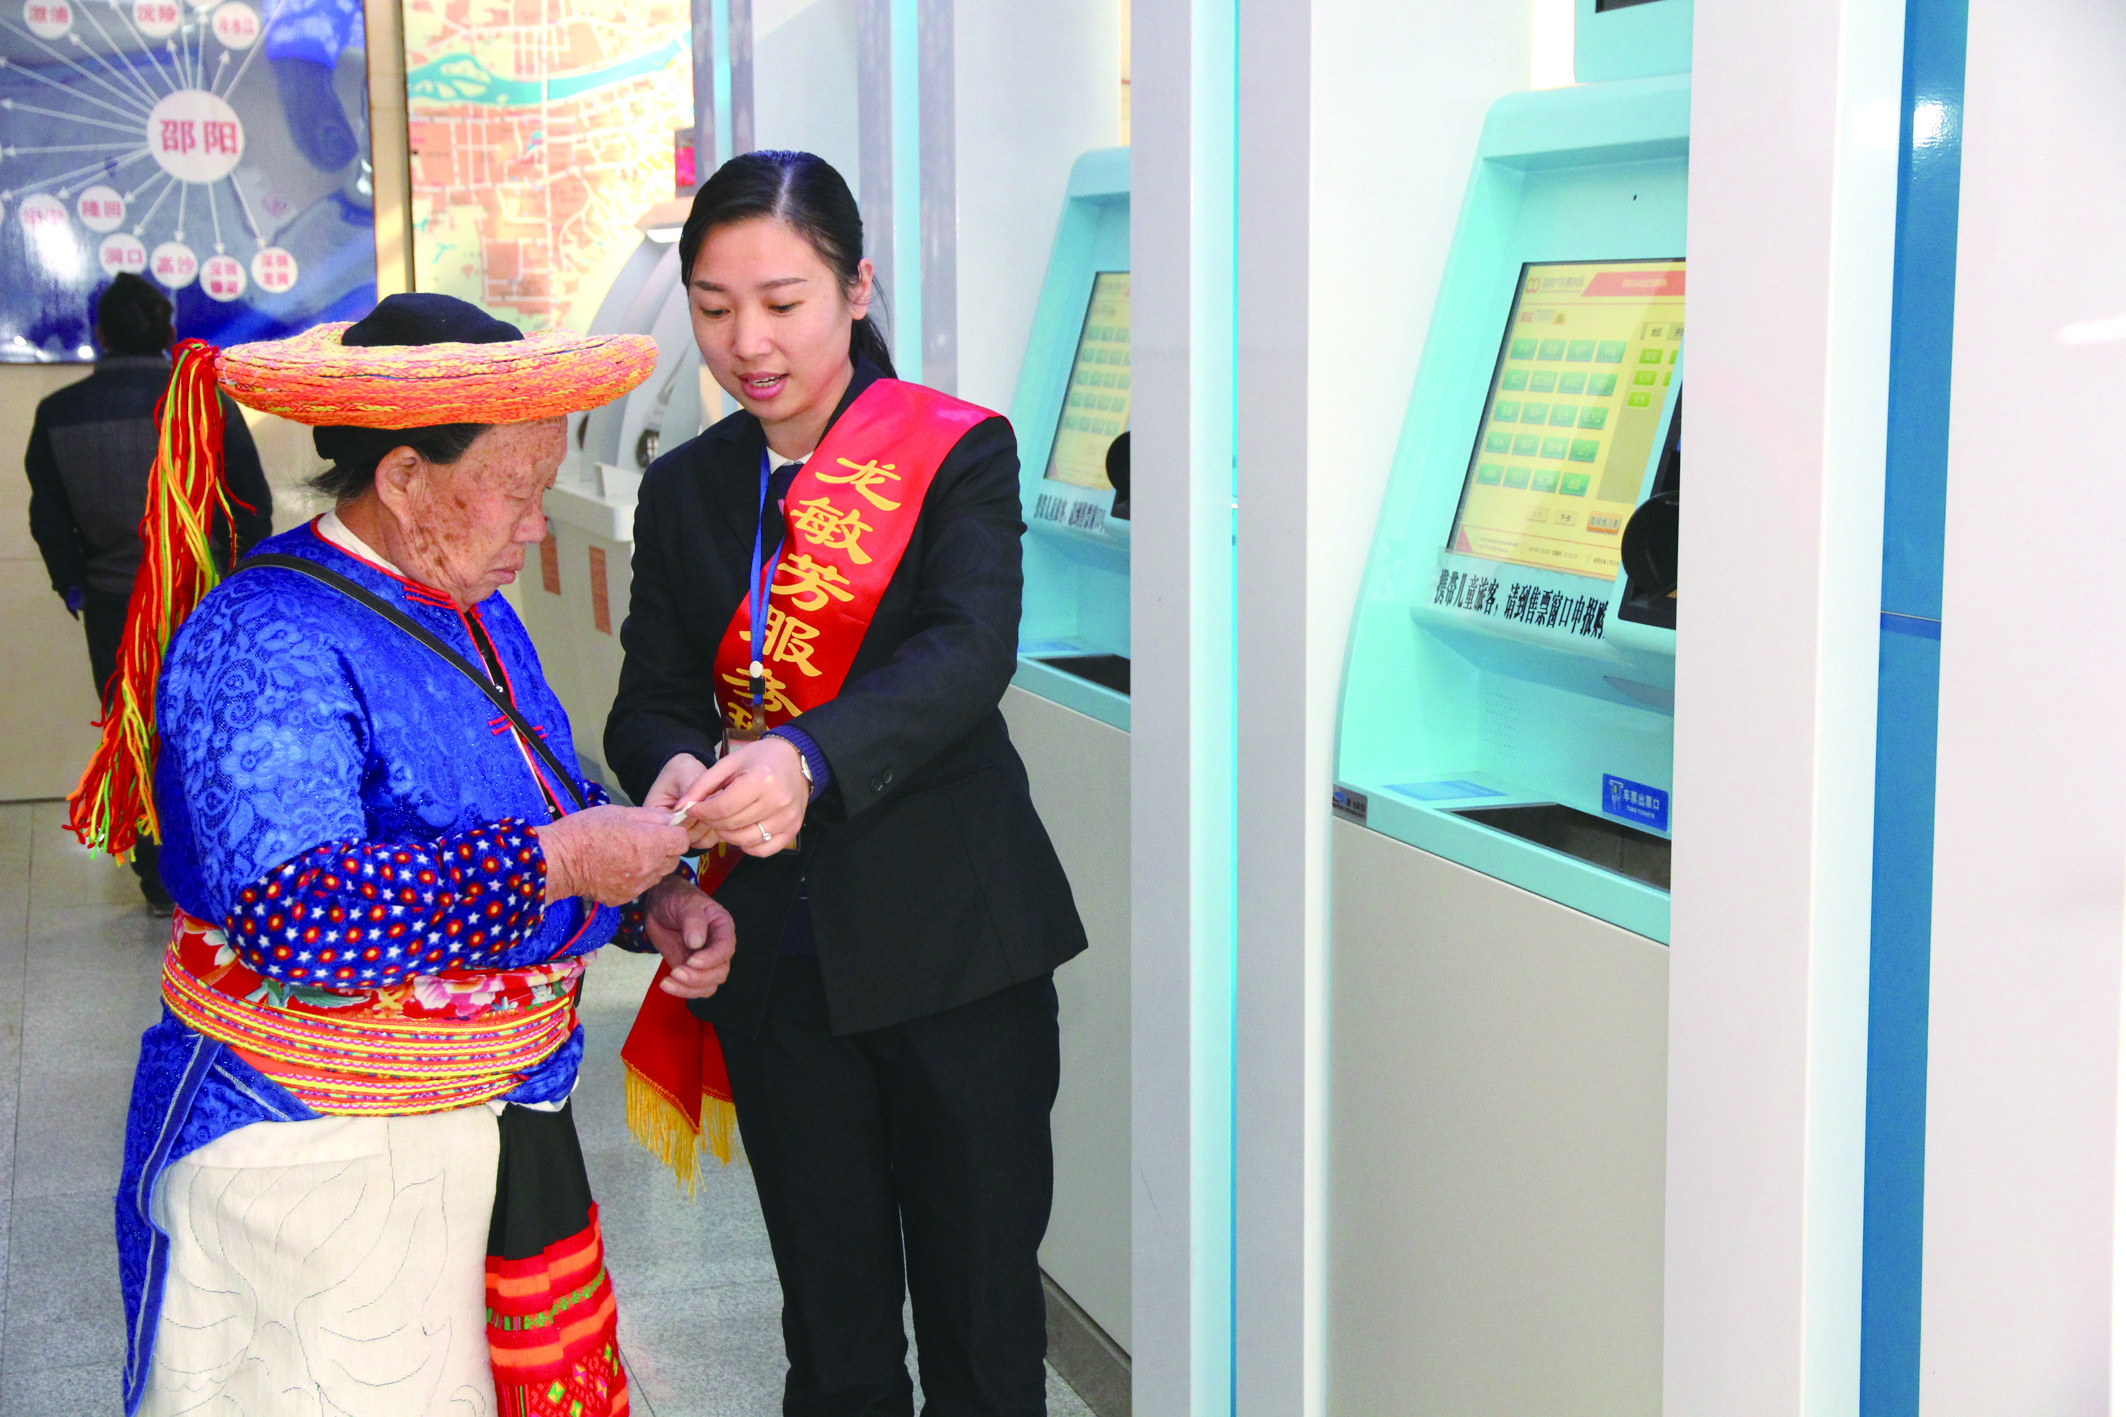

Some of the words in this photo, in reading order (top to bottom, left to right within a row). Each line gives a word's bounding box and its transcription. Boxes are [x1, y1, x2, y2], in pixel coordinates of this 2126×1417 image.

[160, 119, 238, 155] 邵阳
[82, 199, 122, 217] 隆回
[105, 248, 143, 265] 洞口
